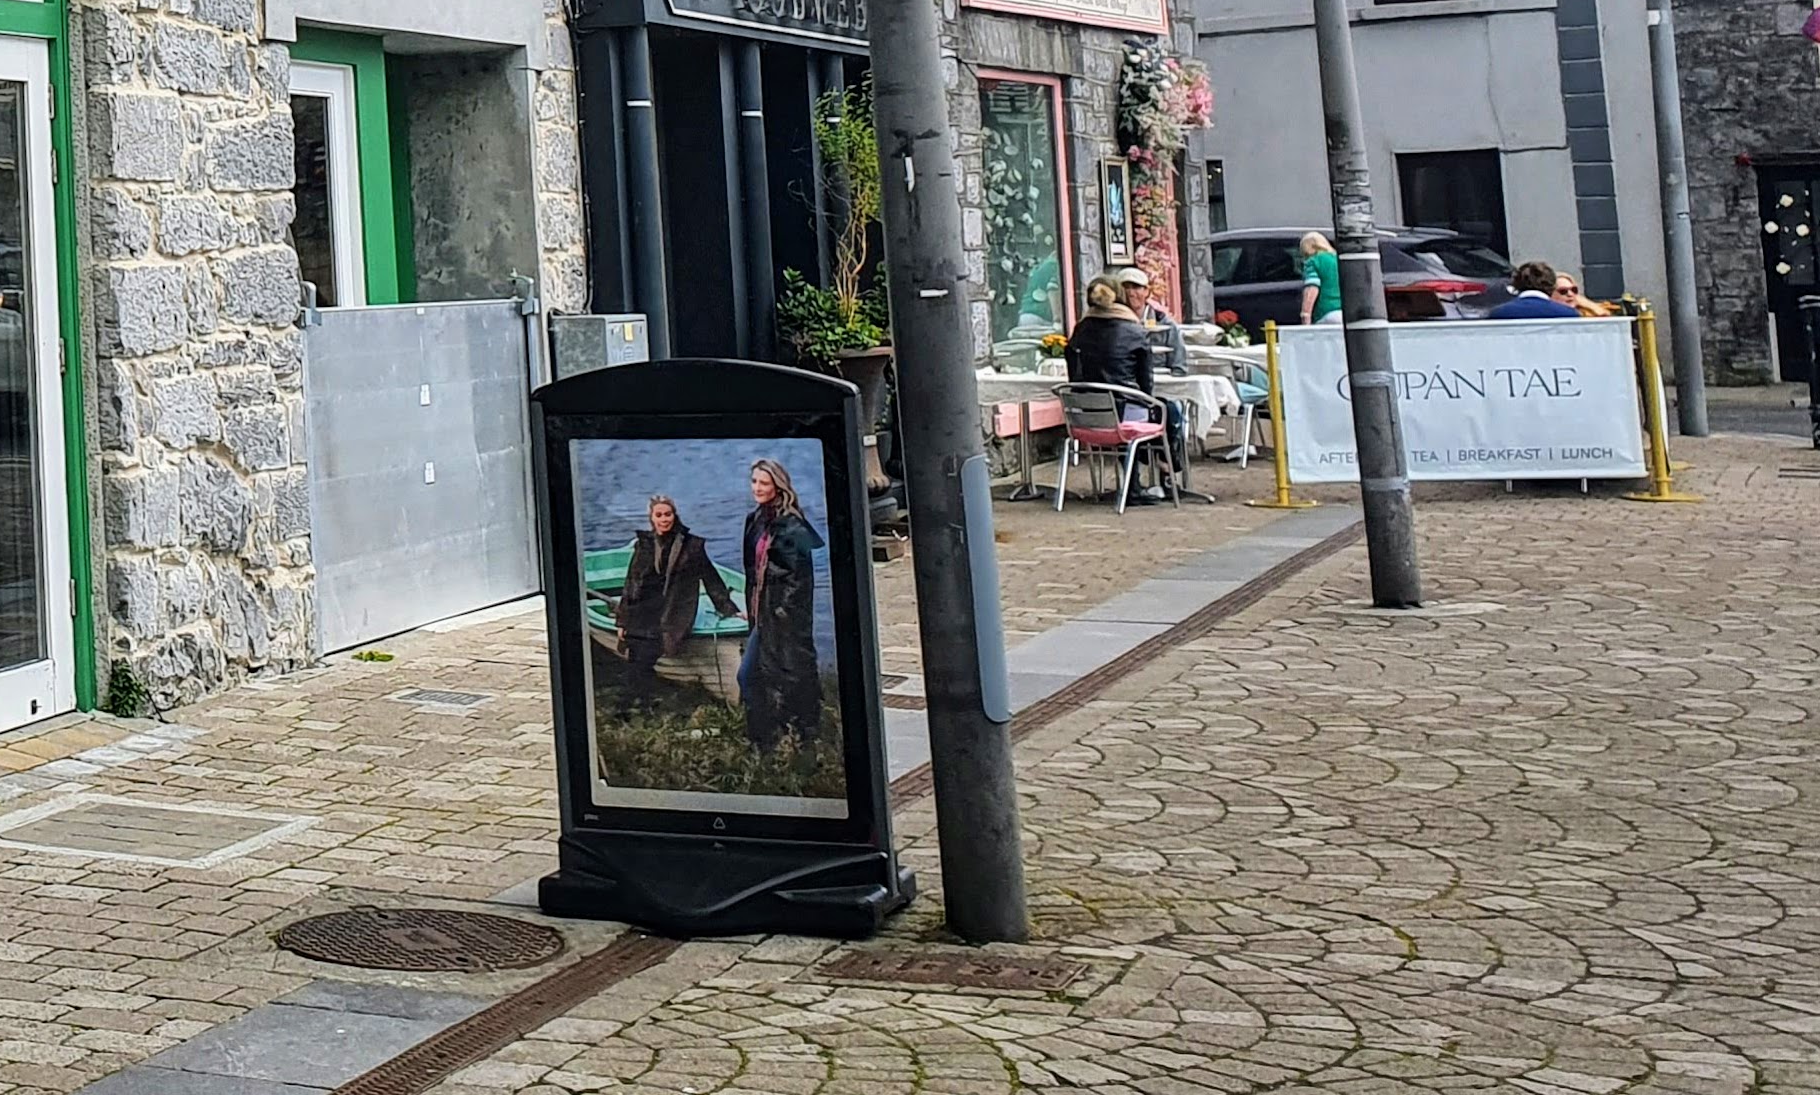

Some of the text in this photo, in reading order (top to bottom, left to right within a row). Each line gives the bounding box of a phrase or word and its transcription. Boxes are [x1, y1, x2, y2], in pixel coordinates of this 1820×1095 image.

[1493, 367, 1583, 398] TAE
[1410, 449, 1440, 463] TEA
[1457, 447, 1542, 462] BREAKFAST
[1560, 446, 1614, 460] LUNCH
